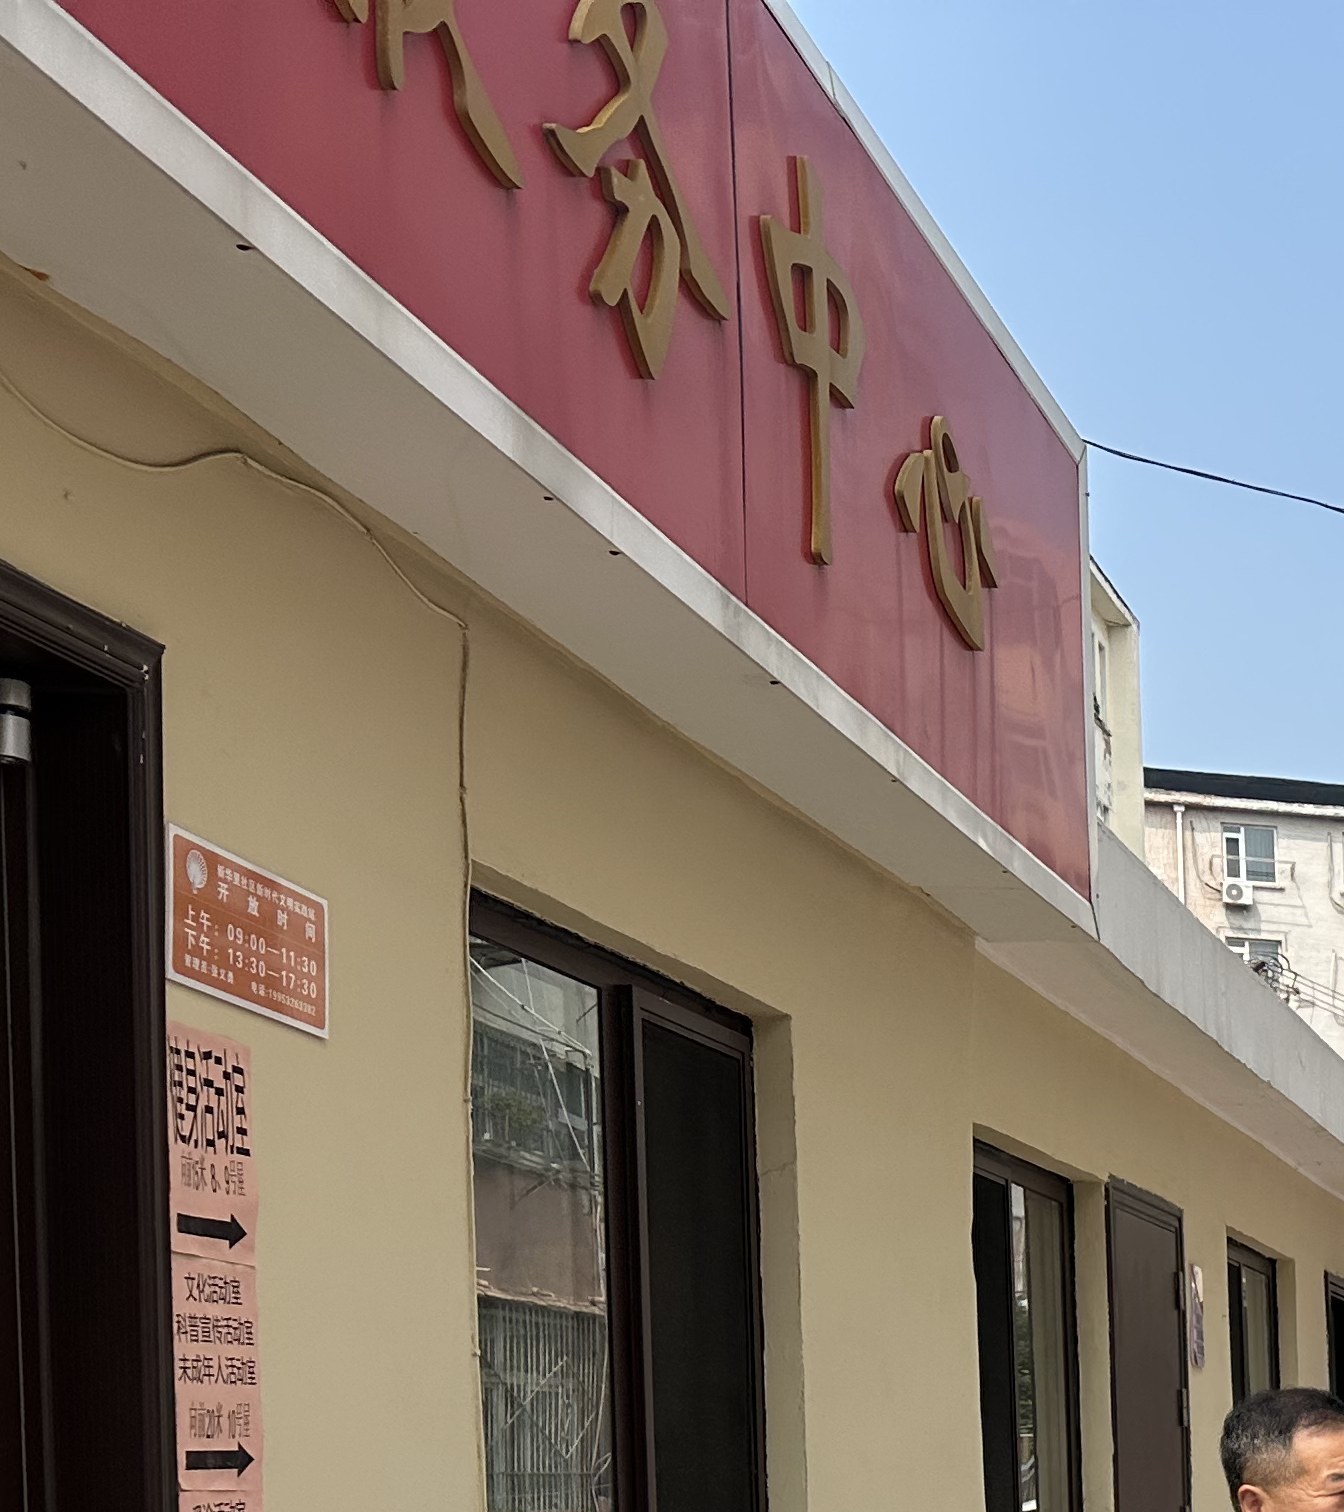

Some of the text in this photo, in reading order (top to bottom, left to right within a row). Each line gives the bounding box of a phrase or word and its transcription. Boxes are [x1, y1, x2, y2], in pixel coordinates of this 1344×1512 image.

[217, 881, 316, 943] 开放时间
[168, 1035, 251, 1157] 健身活动室
[184, 1272, 243, 1306] 文化活动室
[175, 1313, 255, 1346] 科普宣传活动室
[178, 1353, 258, 1386] 未成年人活动室
